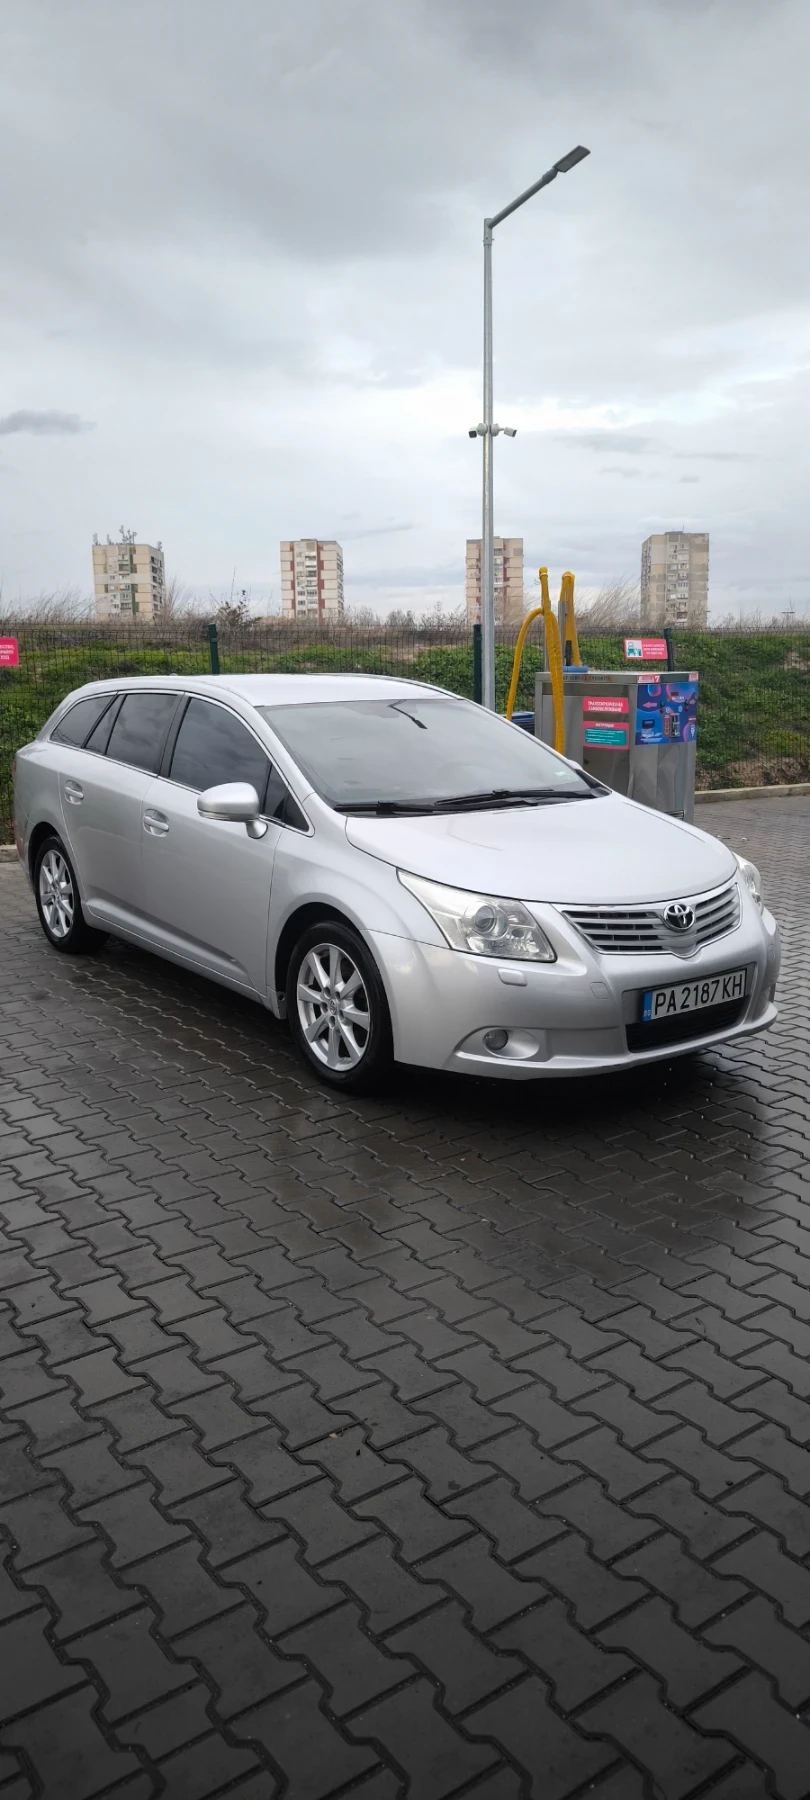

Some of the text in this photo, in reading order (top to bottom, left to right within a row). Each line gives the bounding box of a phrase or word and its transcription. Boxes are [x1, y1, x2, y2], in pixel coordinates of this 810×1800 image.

[655, 974, 743, 1015] PA 2187 KH
